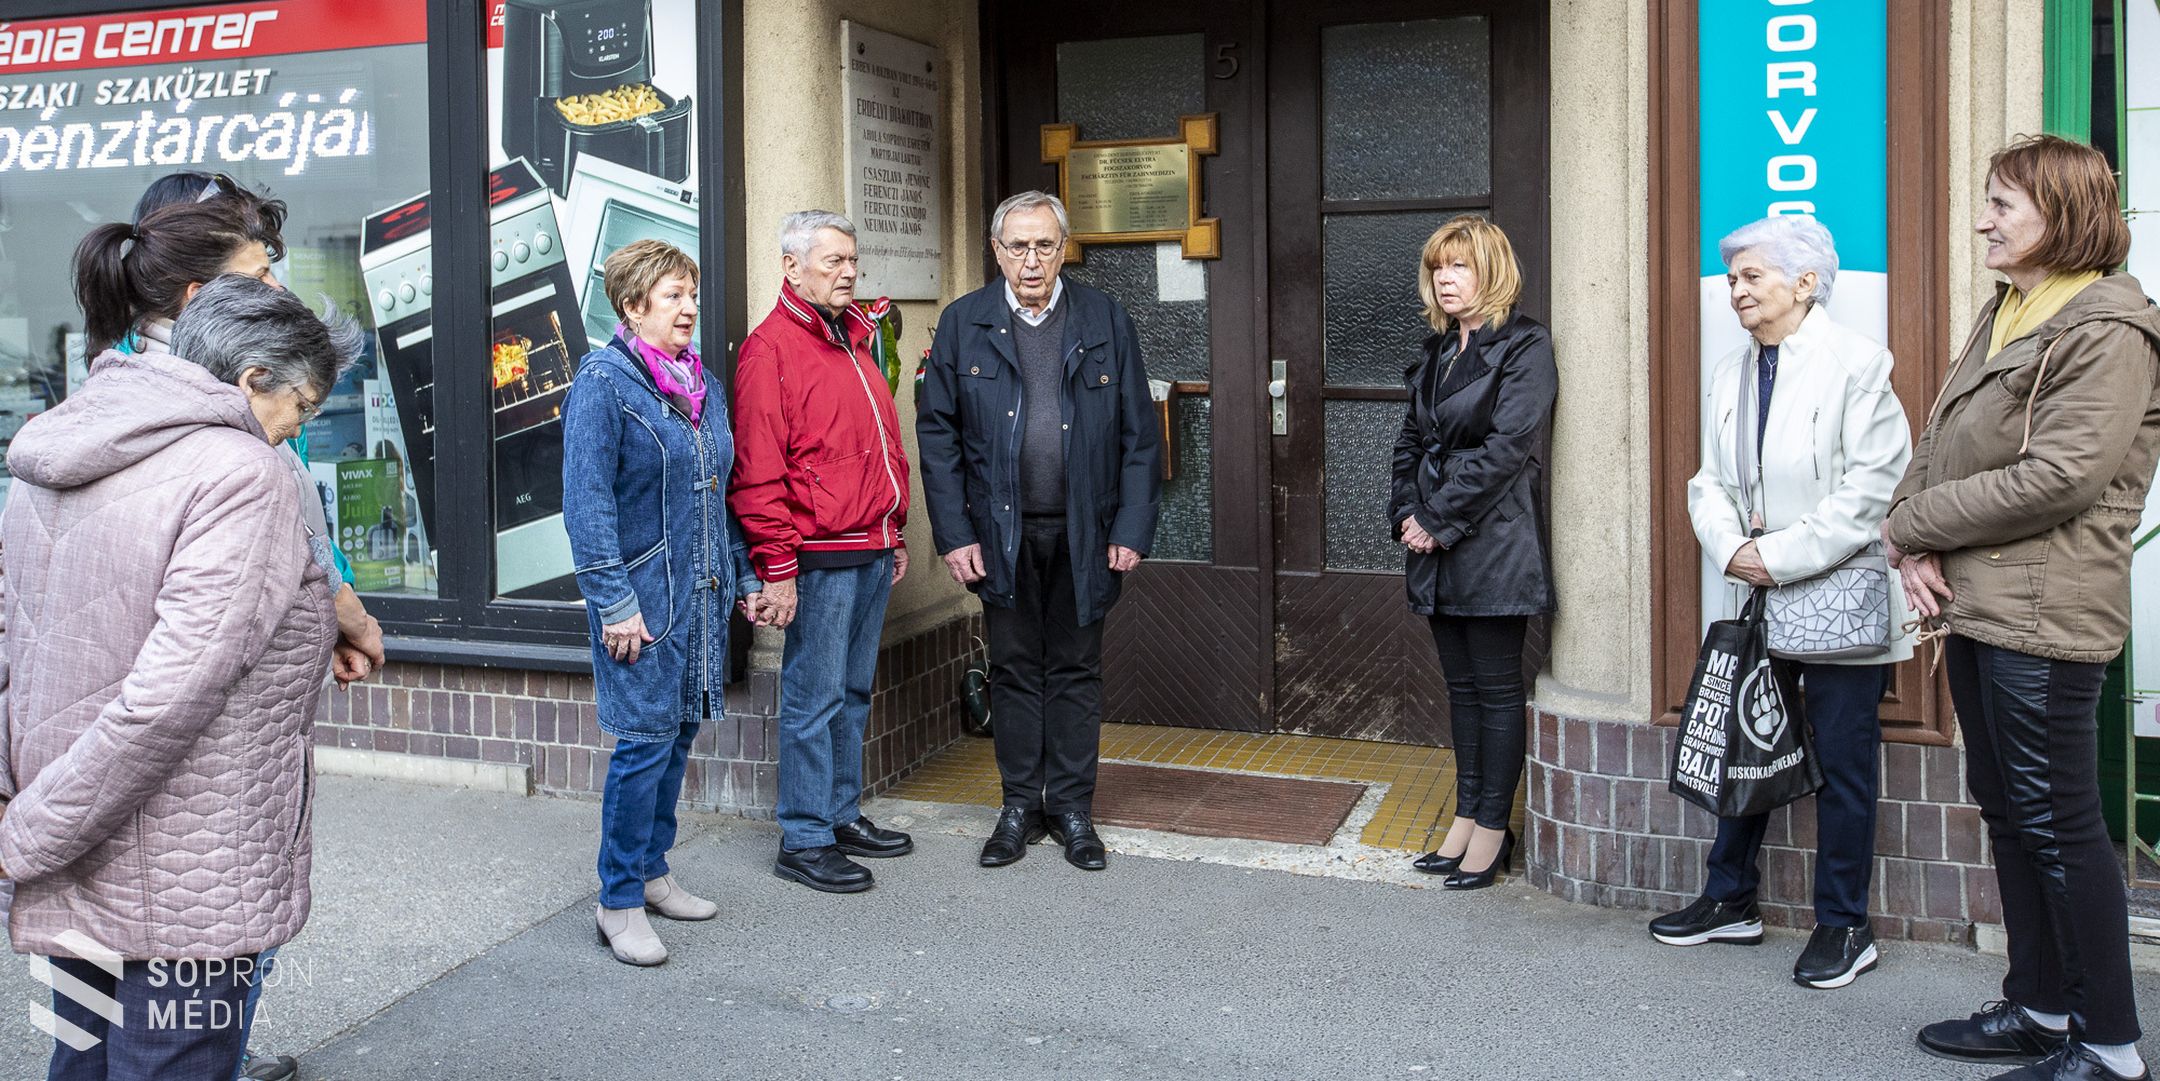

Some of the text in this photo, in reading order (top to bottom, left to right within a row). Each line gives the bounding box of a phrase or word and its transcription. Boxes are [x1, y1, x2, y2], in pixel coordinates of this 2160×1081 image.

[597, 27, 615, 41] 200
[1215, 43, 1240, 79] 5
[95, 67, 272, 106] SZAKÜZLET
[1767, 0, 1818, 225] ORVOS
[863, 184, 922, 203] FERENCZI JÁNOS
[864, 200, 899, 218] FERENCZI
[864, 217, 922, 237] NEUMANN JÁNOS
[341, 468, 374, 480] VIVAX
[515, 492, 532, 505] AEG
[1706, 676, 1731, 692] SINCE
[1678, 745, 1720, 785] BALA
